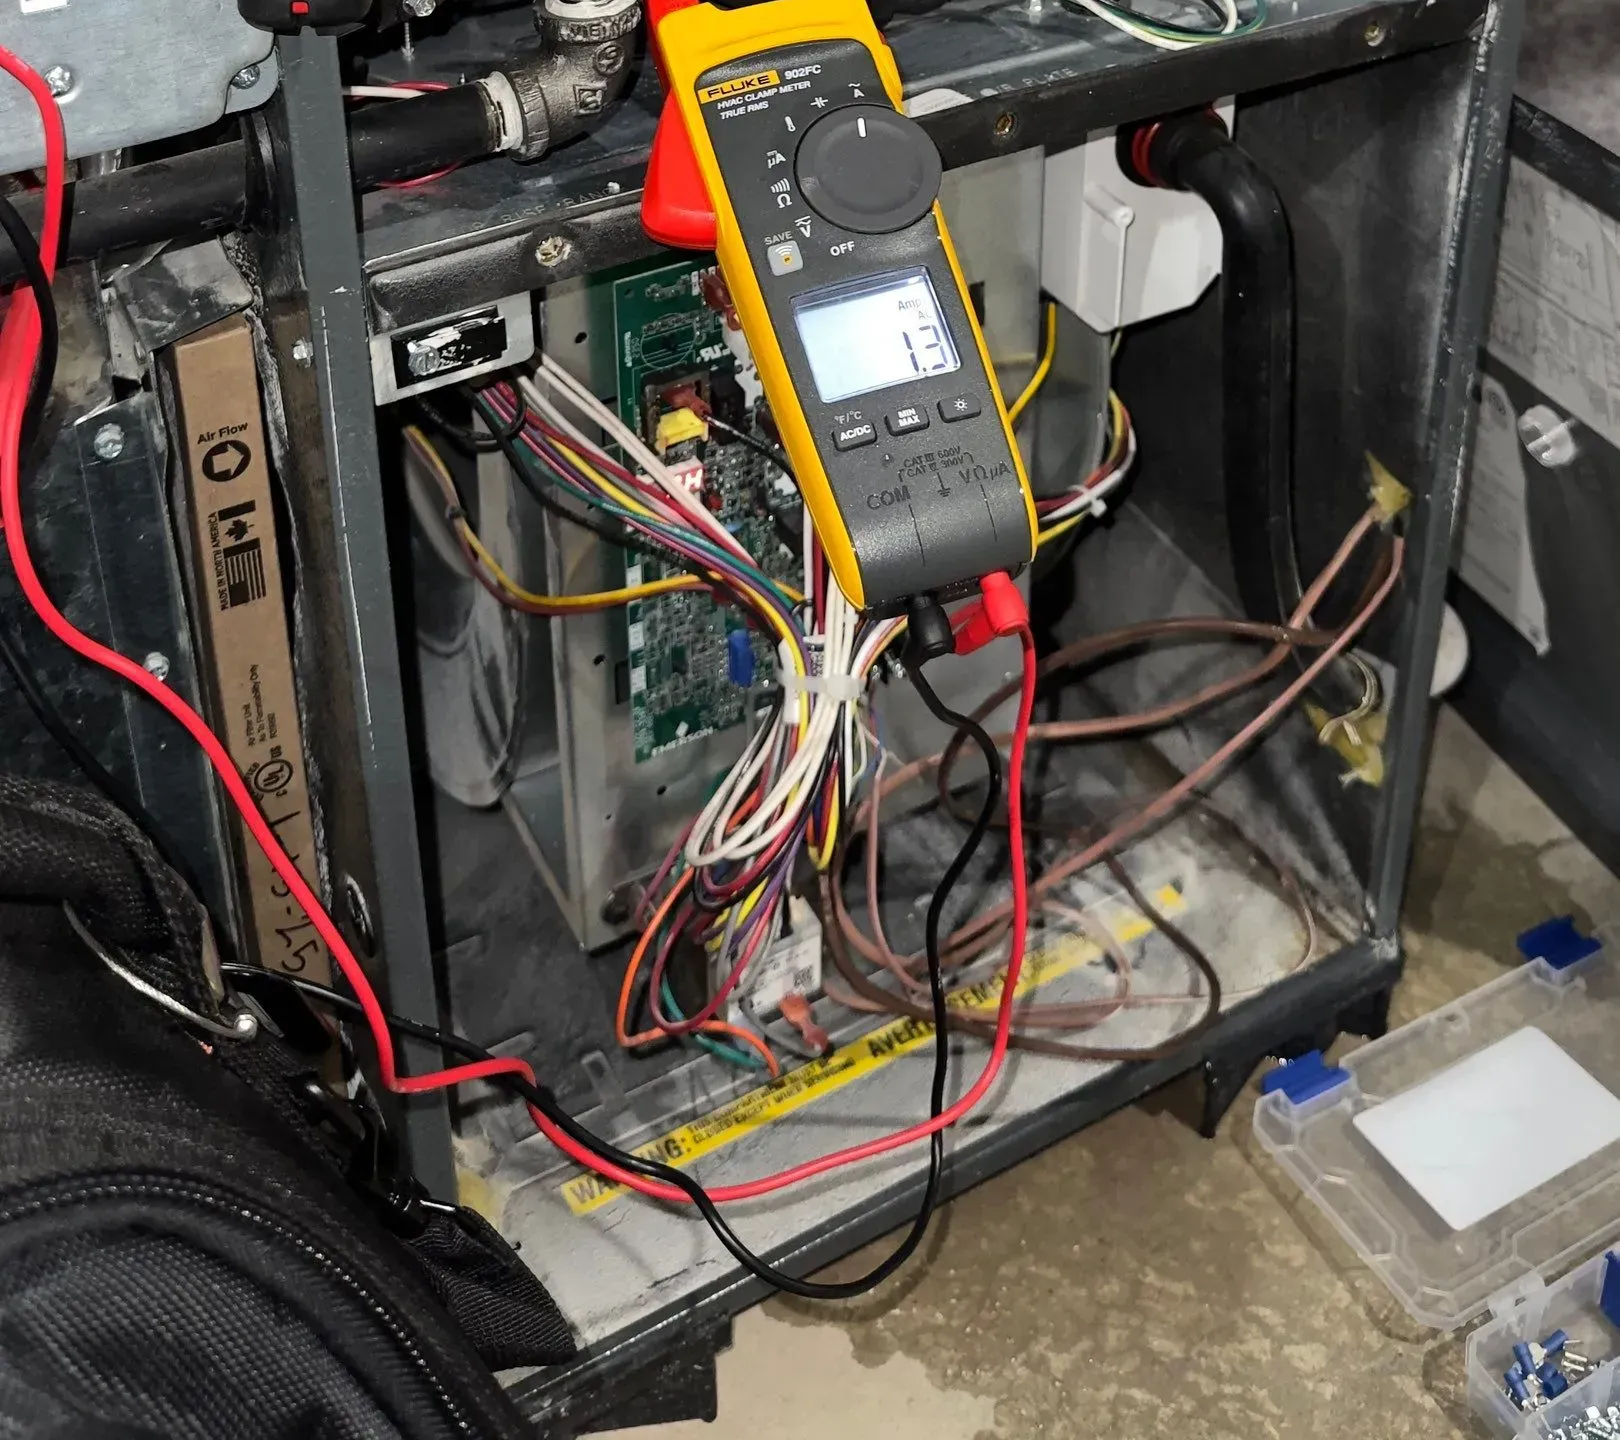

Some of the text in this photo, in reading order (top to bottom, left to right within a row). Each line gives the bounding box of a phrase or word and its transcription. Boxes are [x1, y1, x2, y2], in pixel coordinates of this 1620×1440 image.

[784, 64, 822, 80] 902FC
[707, 75, 771, 98] FLUKE
[717, 80, 811, 110] HVAC CLAMP METER
[719, 101, 770, 120] TRUE RMS
[764, 231, 793, 245] SAVE
[830, 241, 855, 257] OFF
[902, 325, 948, 373] 1.3
[897, 407, 916, 419] MIN
[898, 414, 920, 427] MAX
[197, 422, 249, 445] Air Flow
[840, 424, 871, 442] AC/DC
[903, 454, 925, 468] CAT
[937, 446, 961, 458] 600V
[906, 462, 929, 477] CAT
[866, 485, 911, 510] COM
[208, 511, 229, 611] MADE IN NORTH AMERICA
